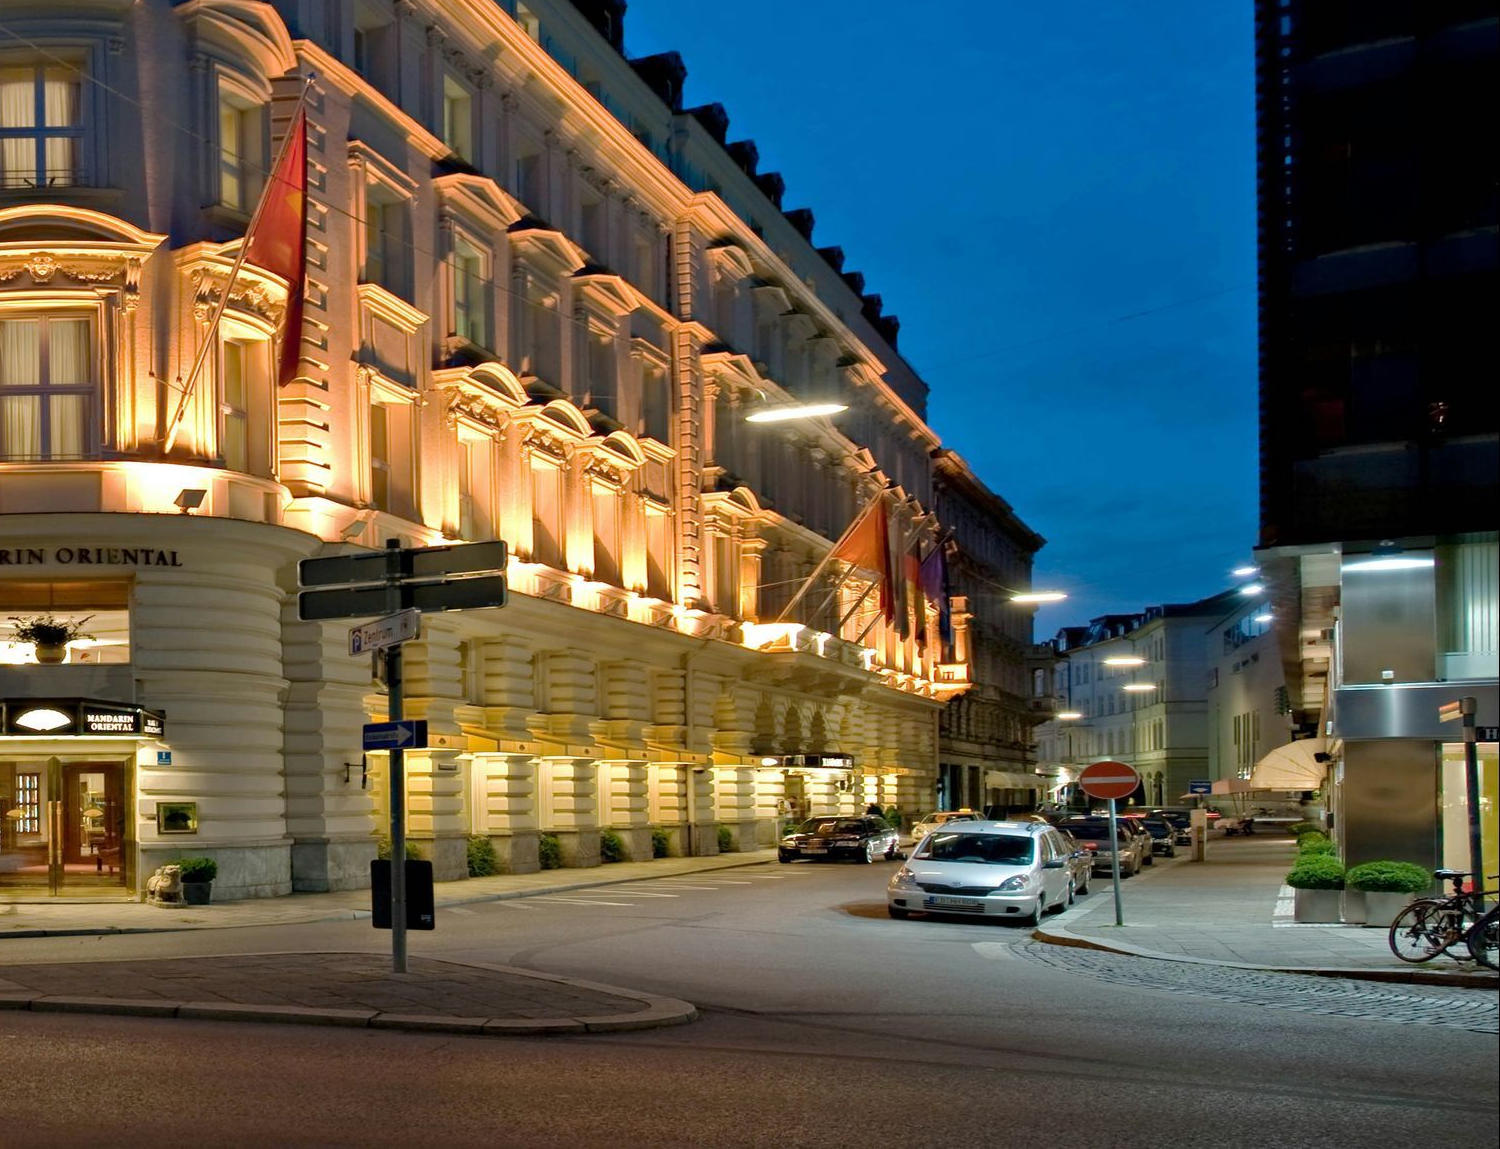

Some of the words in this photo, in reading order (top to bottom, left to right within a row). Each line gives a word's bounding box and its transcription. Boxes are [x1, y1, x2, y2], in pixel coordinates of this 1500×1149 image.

[55, 548, 183, 567] ORIENTAL
[363, 627, 394, 646] Zentrum
[87, 714, 134, 723] MANDARIN
[90, 723, 134, 732] ORIENTAL
[1485, 728, 1499, 740] H
